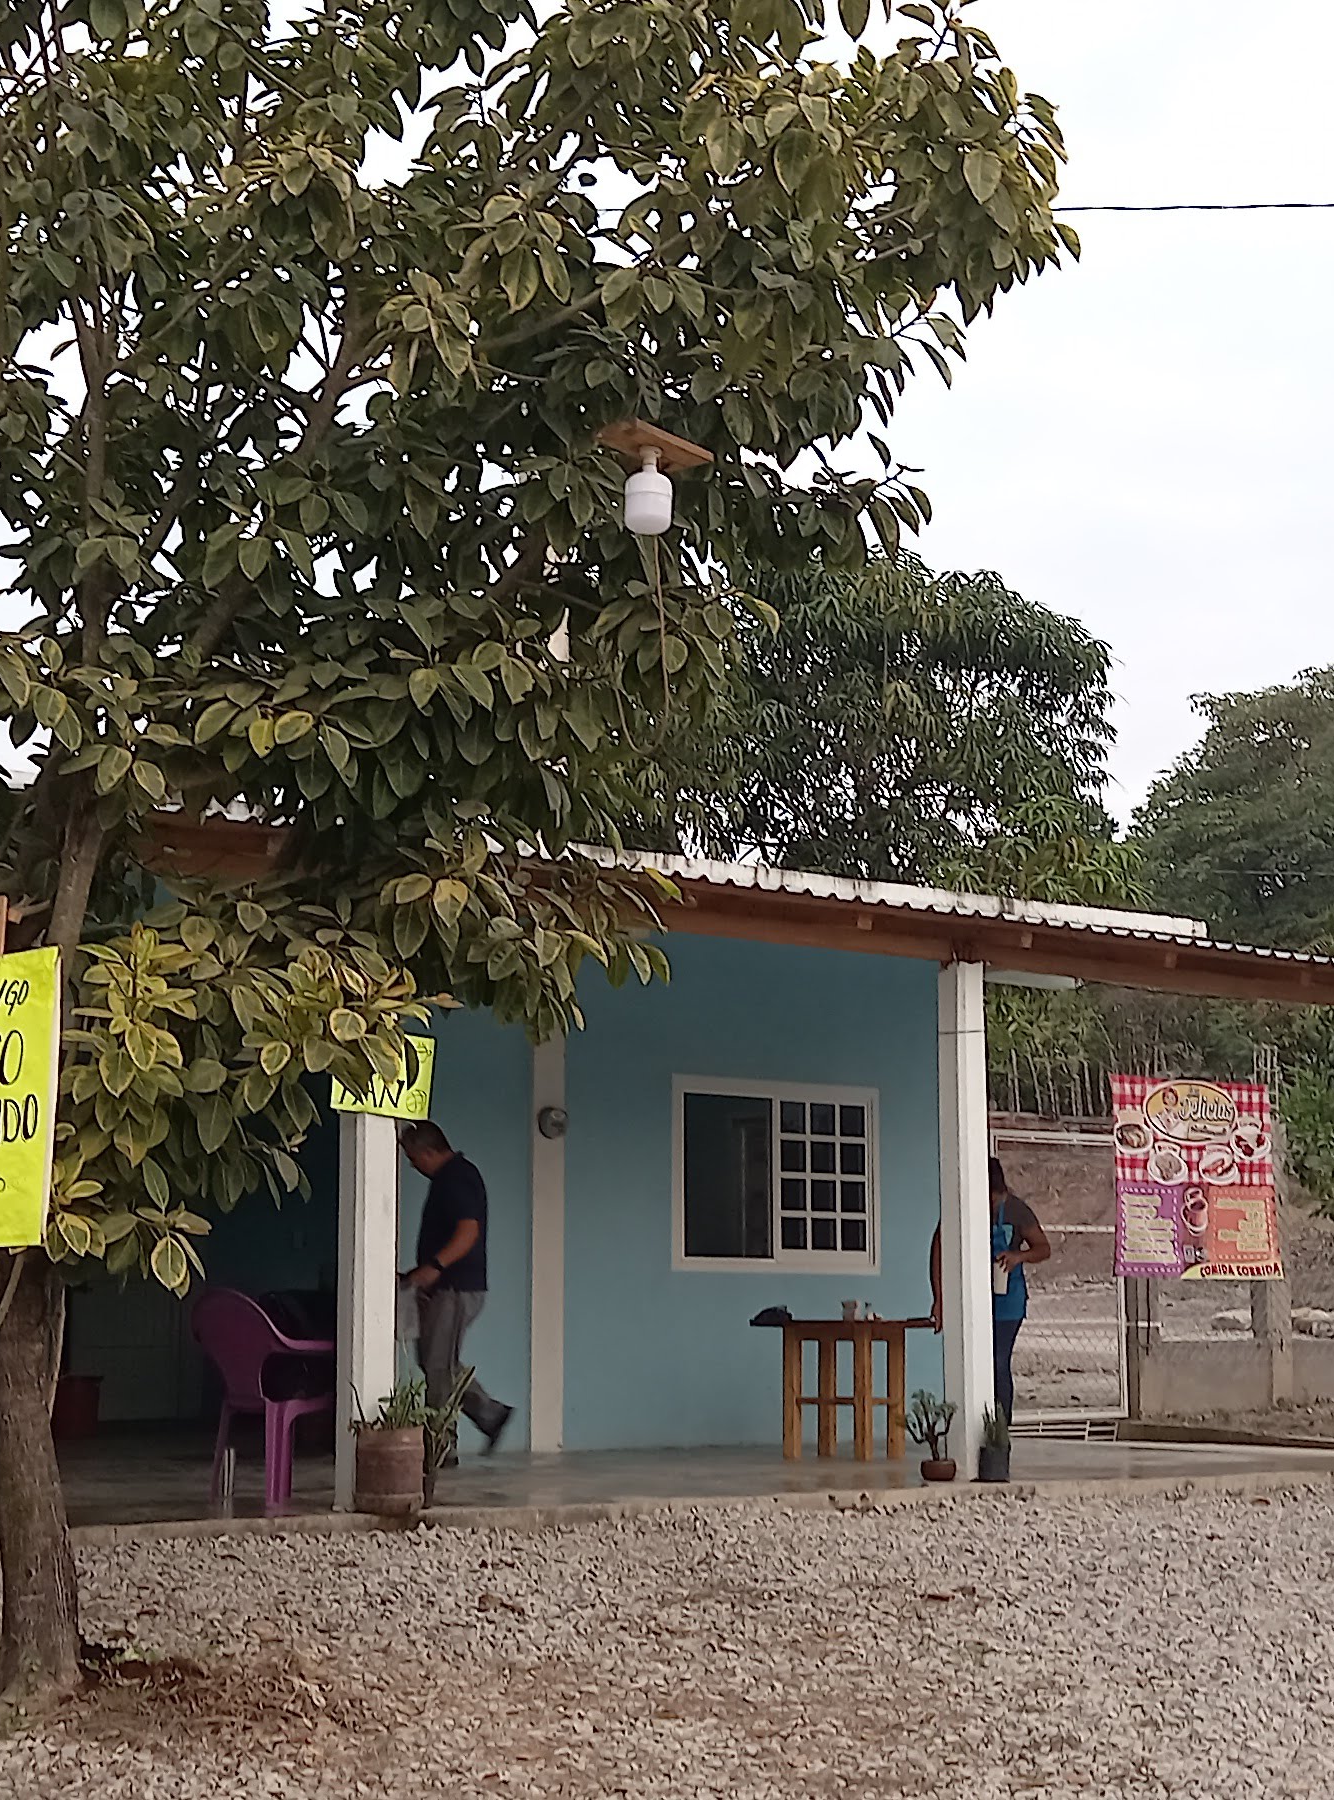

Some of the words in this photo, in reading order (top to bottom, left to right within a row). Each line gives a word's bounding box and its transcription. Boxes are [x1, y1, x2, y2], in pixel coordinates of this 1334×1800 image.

[1178, 1095, 1234, 1122] Delicias
[1200, 1264, 1235, 1277] COMIDA
[1236, 1262, 1281, 1277] CORRIDA
